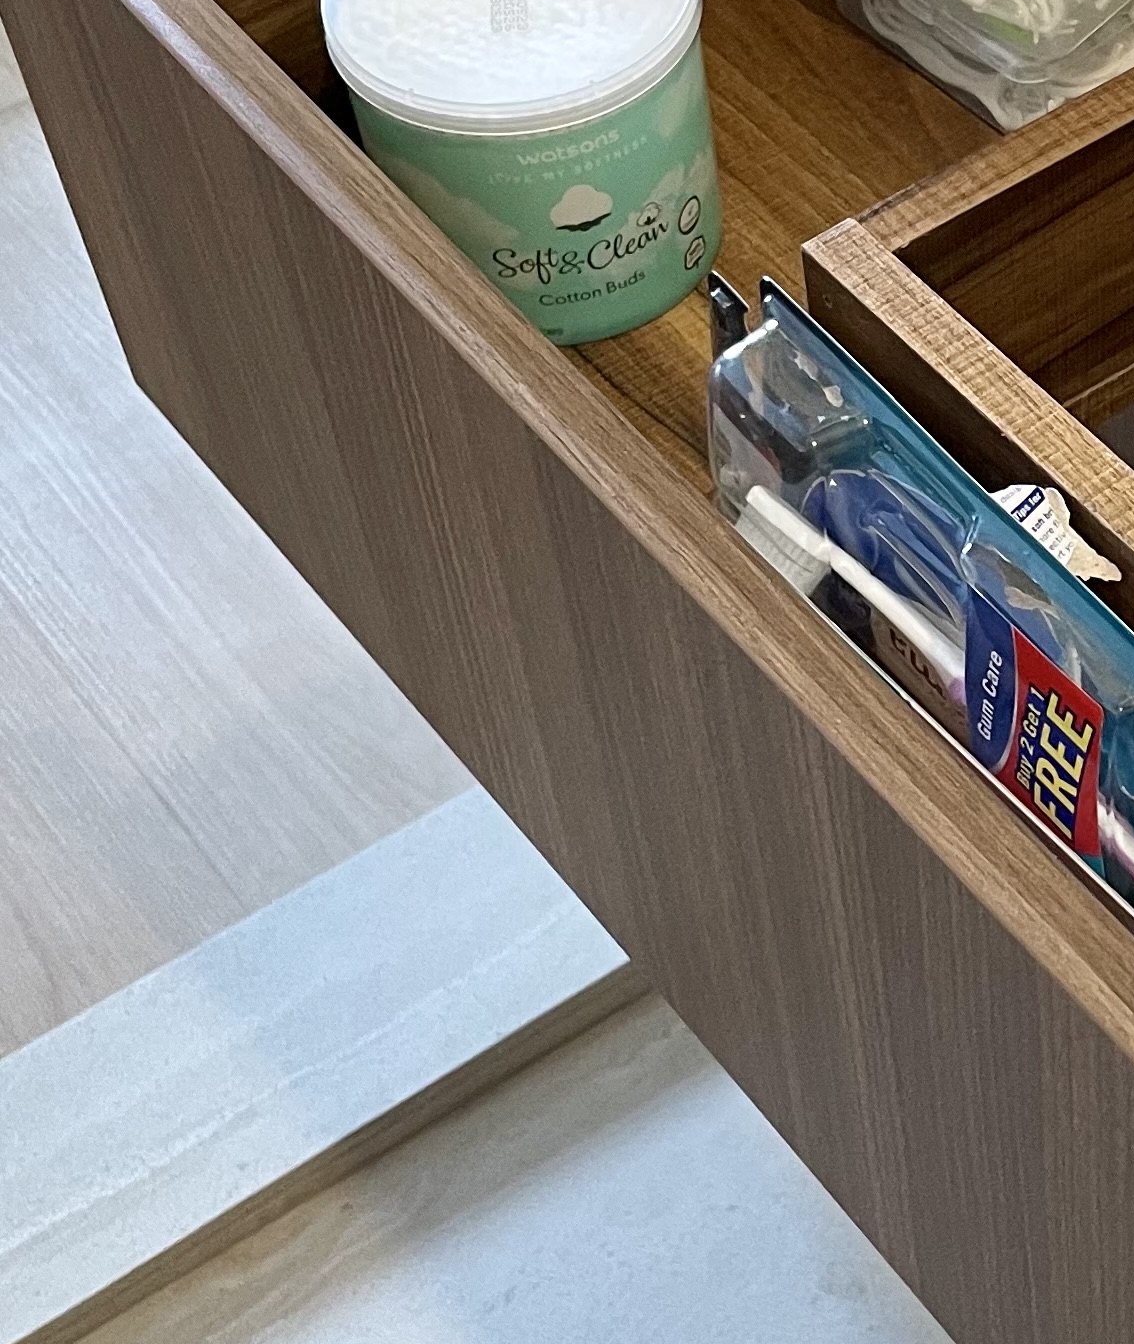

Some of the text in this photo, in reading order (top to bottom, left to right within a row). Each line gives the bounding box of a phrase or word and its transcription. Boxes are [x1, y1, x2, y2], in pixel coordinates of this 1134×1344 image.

[517, 128, 620, 165] watsons
[539, 270, 646, 306] Cotton Buds
[1013, 492, 1041, 521] Tips for
[977, 650, 1002, 740] Gum Care
[1016, 687, 1044, 790] Buy 2 Get 1
[1034, 693, 1093, 839] FREE
